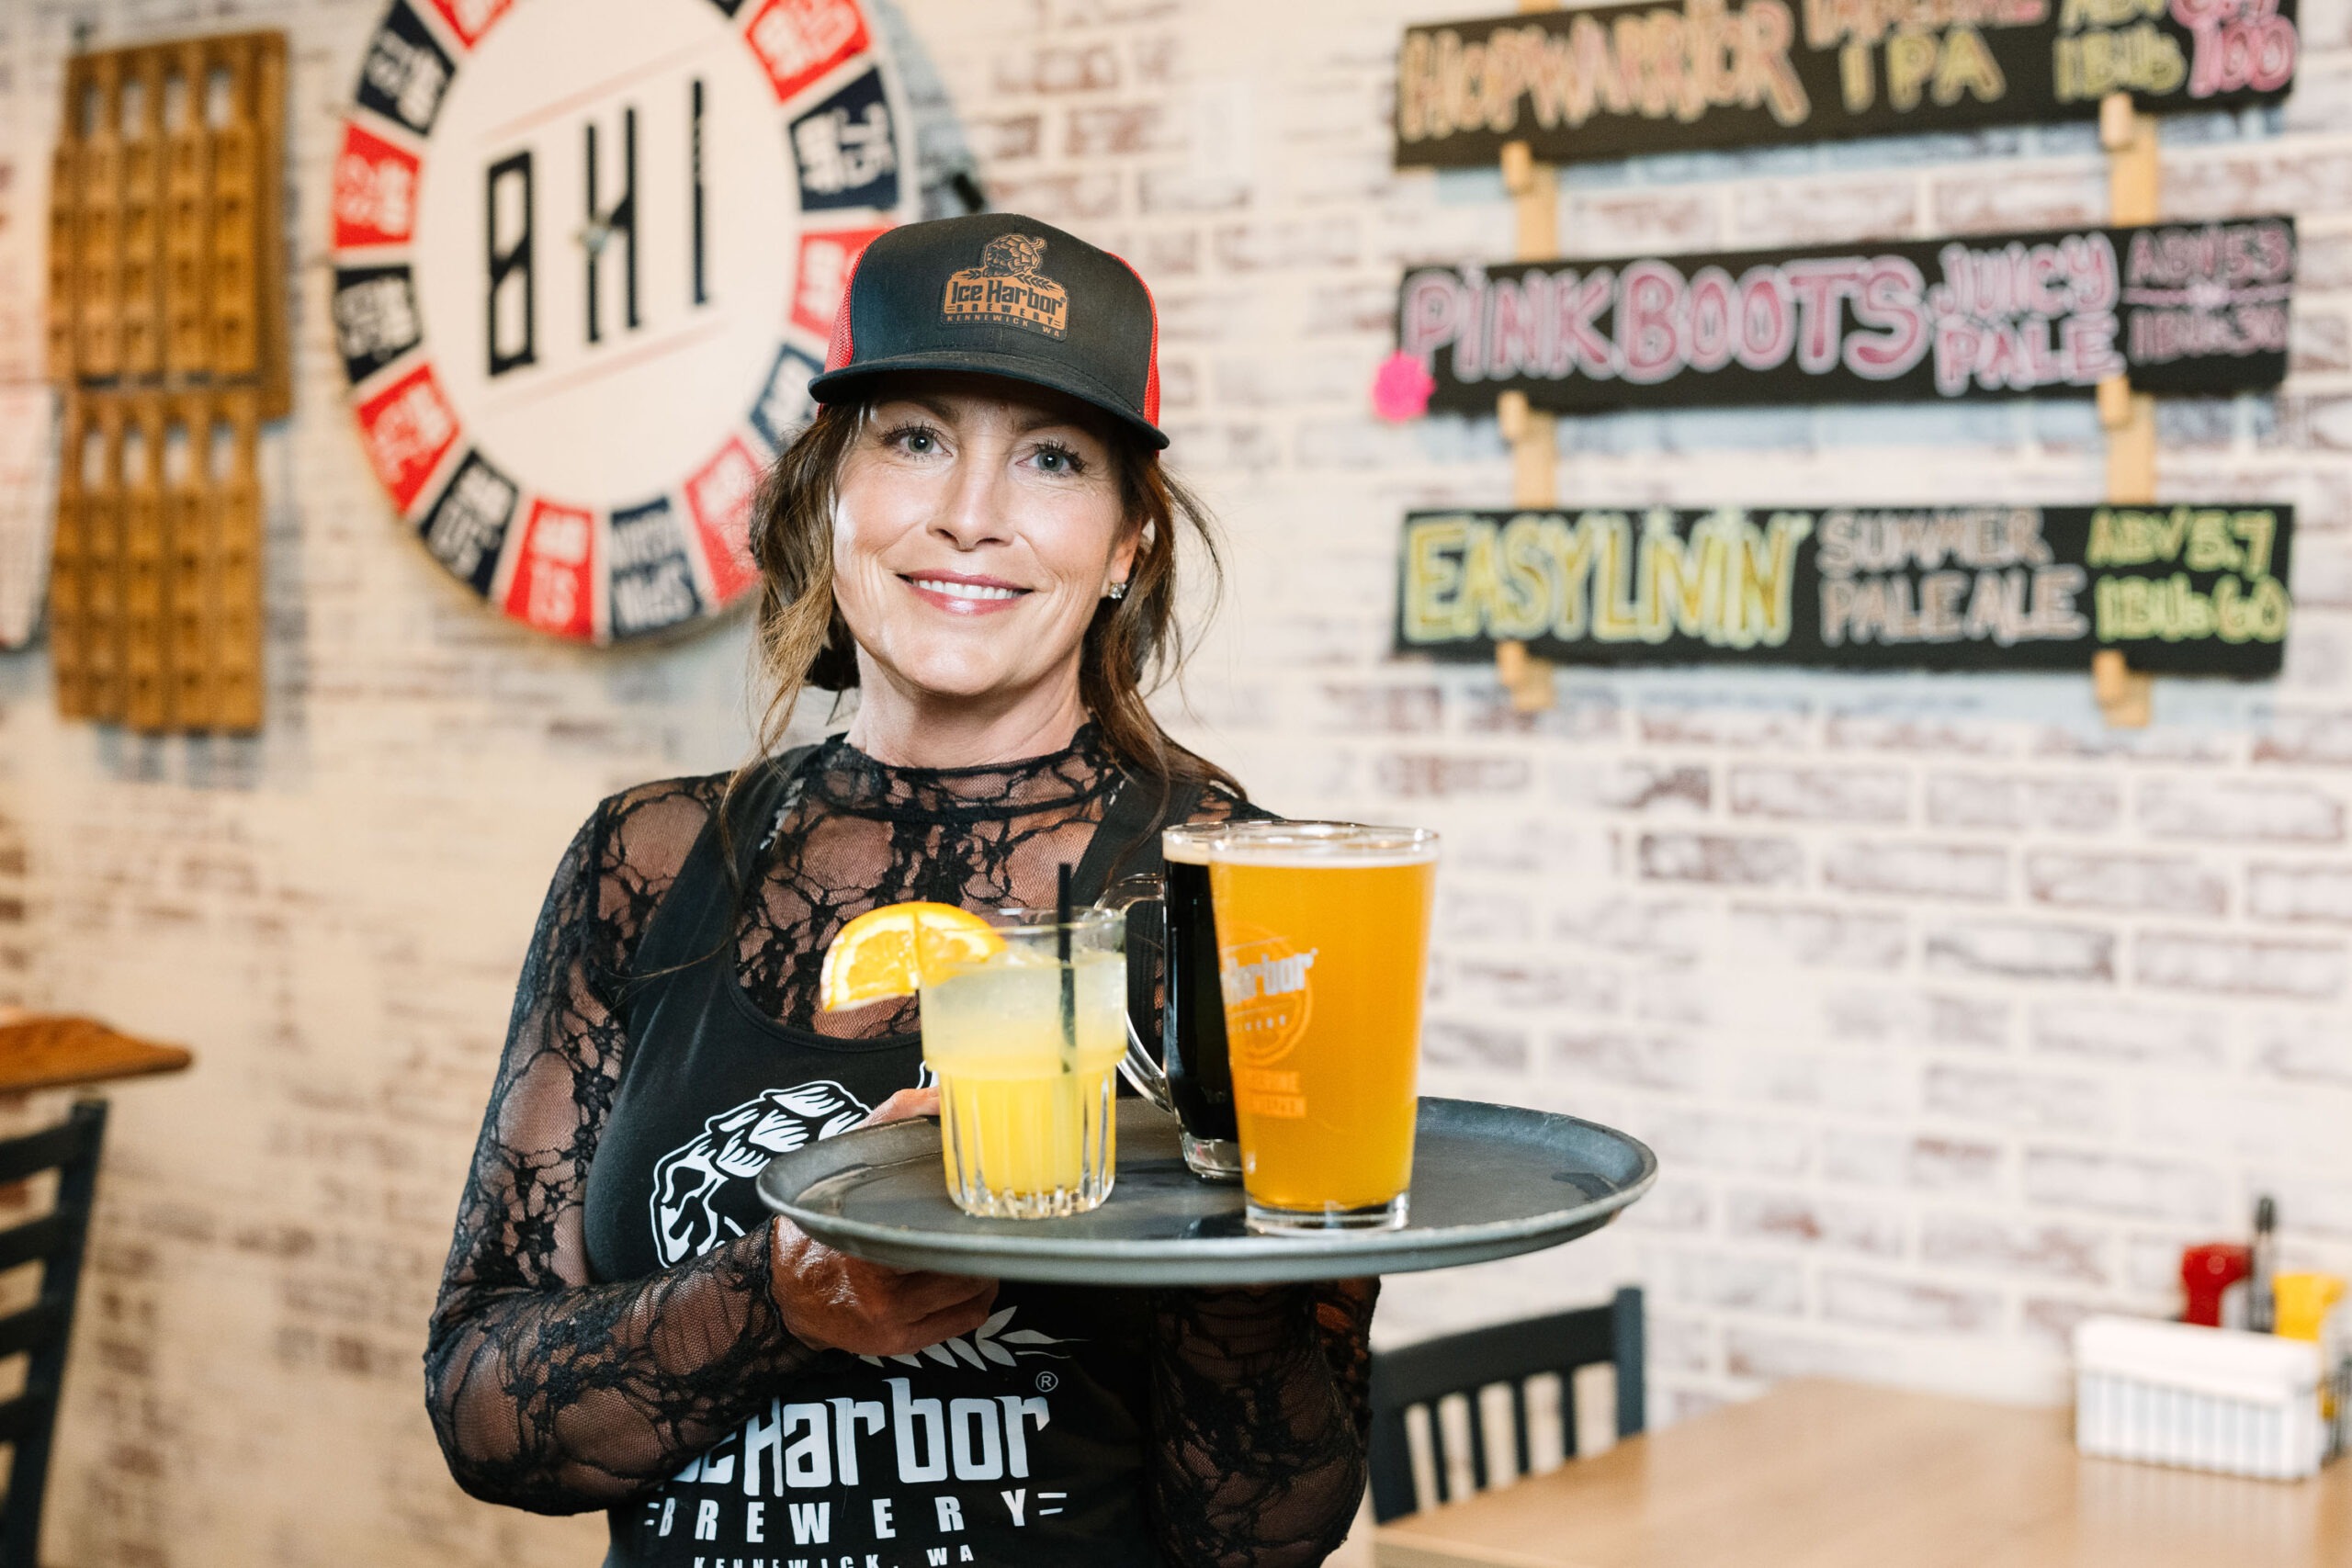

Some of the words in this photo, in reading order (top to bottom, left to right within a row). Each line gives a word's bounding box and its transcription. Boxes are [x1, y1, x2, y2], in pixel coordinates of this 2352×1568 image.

[1838, 30, 2007, 115] IPA
[2187, 15, 2298, 99] 100
[951, 281, 984, 304] Ice
[987, 279, 1063, 316] Harbor
[956, 303, 1053, 325] BREWERY
[1928, 231, 2121, 320] JUICY
[947, 315, 1029, 328] KENNEWICK
[1043, 325, 1060, 338] WA
[1401, 255, 1624, 383] PINK
[1614, 254, 1932, 385] BOOTS
[1933, 310, 2128, 397] PALE
[1402, 512, 1595, 644] EASY
[1815, 505, 2056, 581] SUMMER
[1818, 563, 1972, 648] PALE
[1962, 562, 2092, 648] ALE
[2209, 573, 2293, 644] 60
[744, 1378, 1050, 1497] Harbor
[658, 1488, 1026, 1546] BREWERY
[926, 1544, 974, 1567] WA
